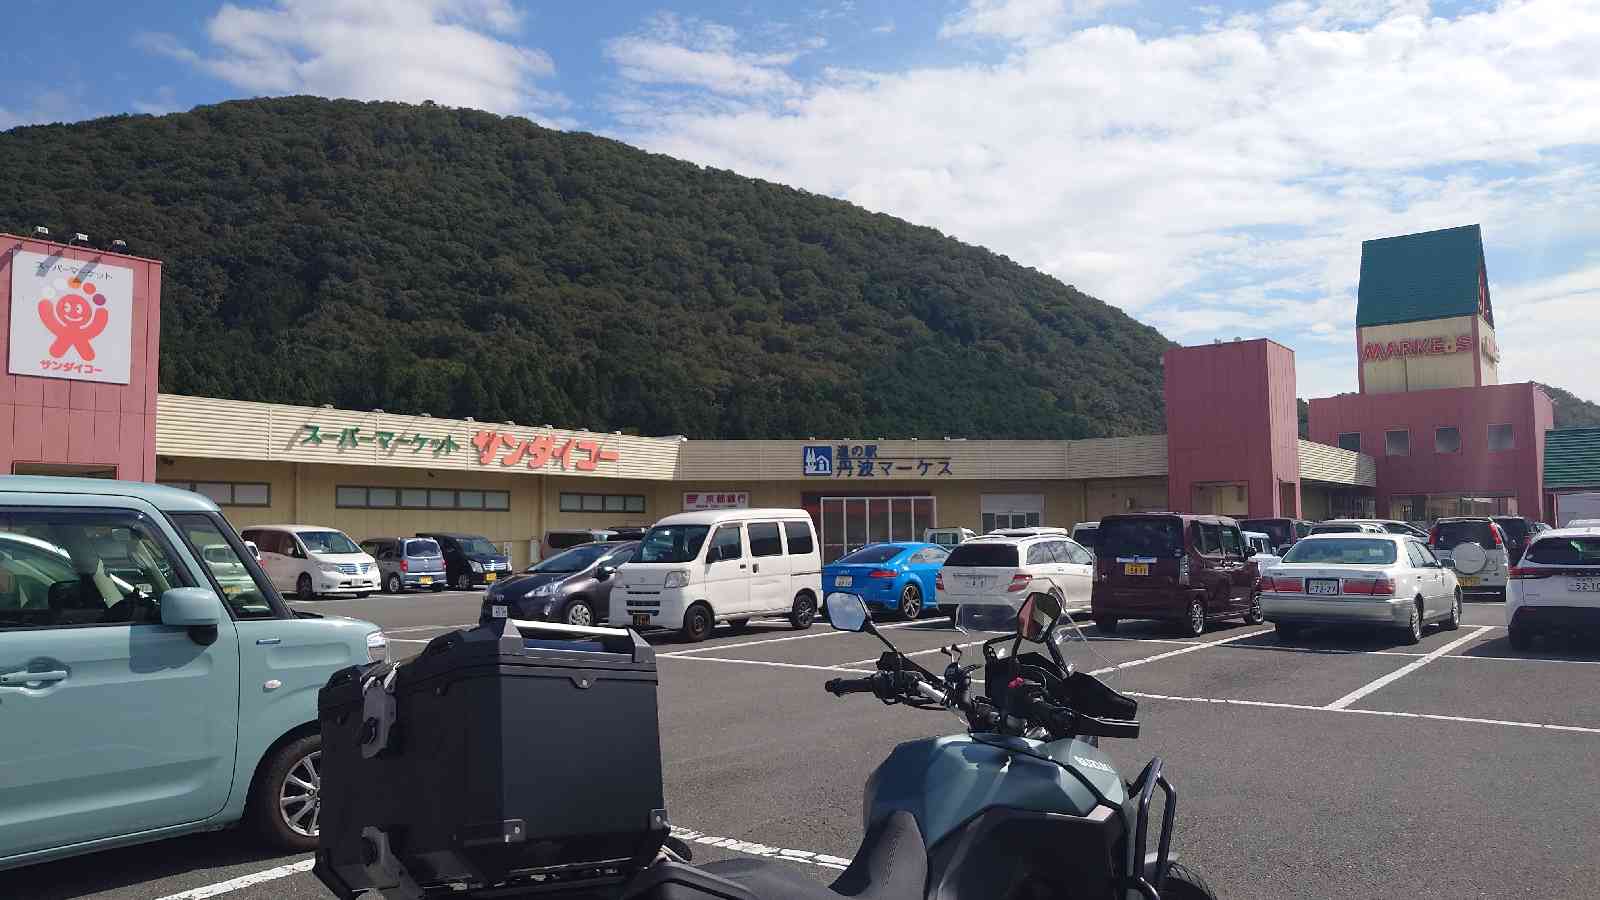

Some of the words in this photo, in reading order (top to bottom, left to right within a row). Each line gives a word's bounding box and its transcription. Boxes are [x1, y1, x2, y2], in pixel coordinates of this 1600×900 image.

[40, 359, 103, 374] サンダイコー
[302, 424, 460, 454] スーパーマーケット
[472, 430, 620, 471] サンダイコー
[836, 444, 878, 458] 道の駅
[836, 460, 953, 478] 丹波マーケス
